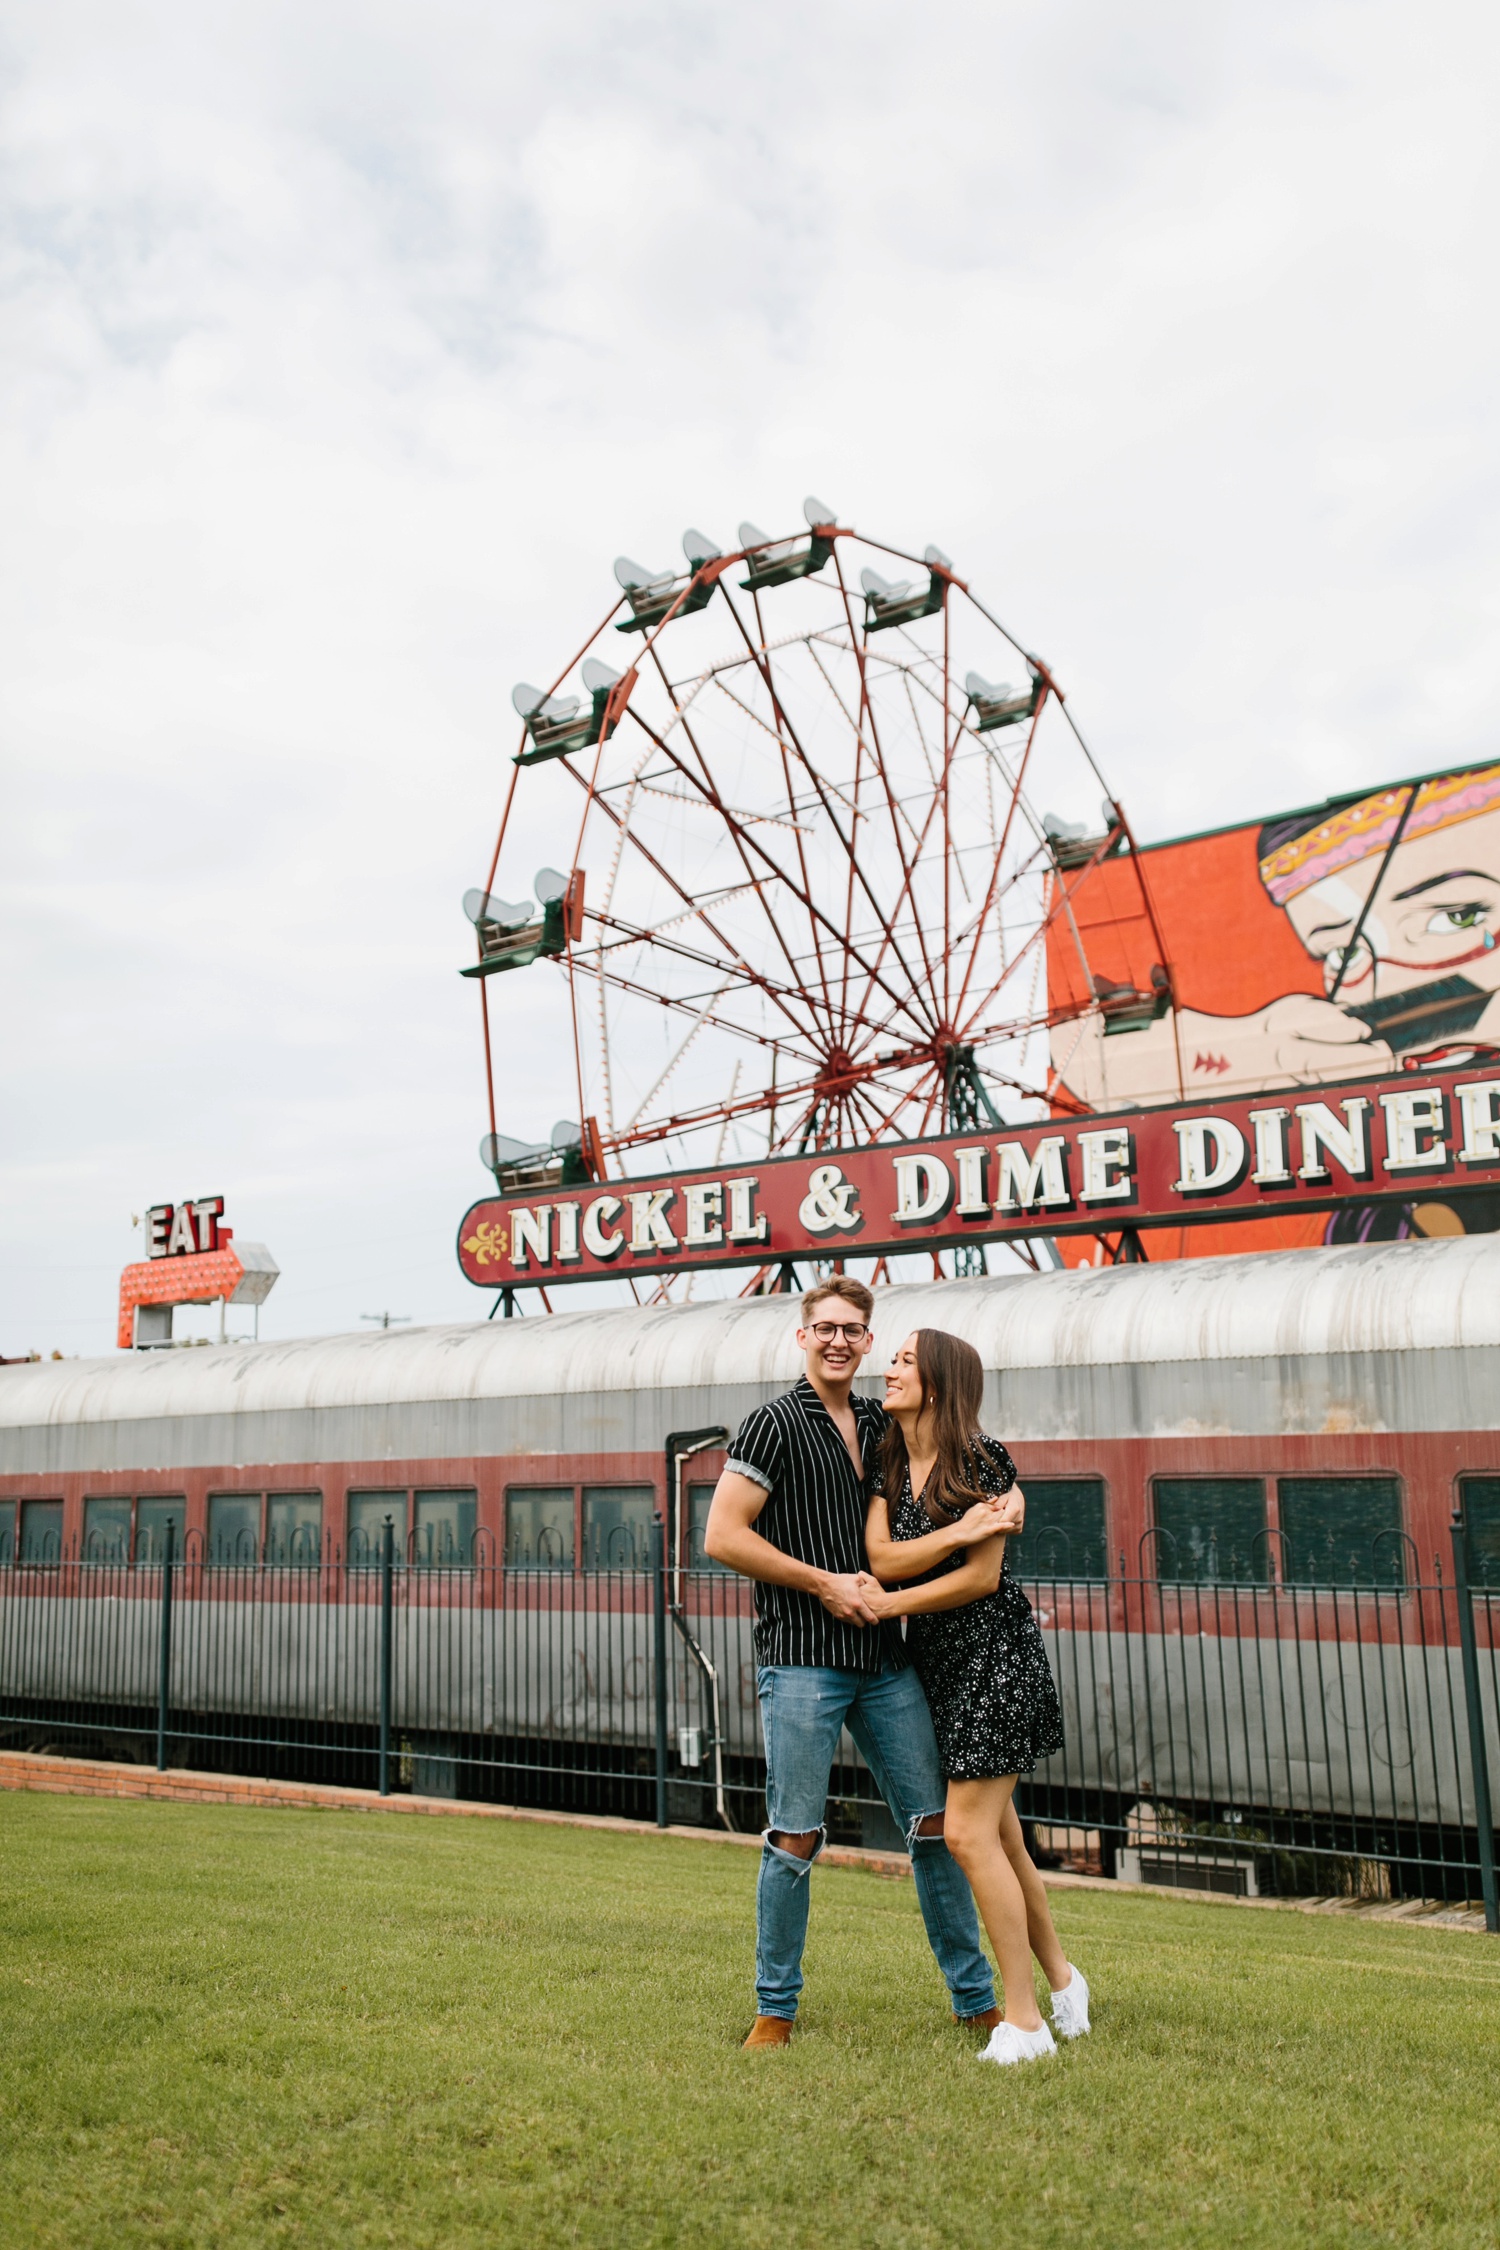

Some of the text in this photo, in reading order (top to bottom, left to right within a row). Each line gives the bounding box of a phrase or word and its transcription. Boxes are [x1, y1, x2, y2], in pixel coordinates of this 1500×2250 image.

[146, 1196, 223, 1259] EAT
[509, 1079, 1500, 1265] NICKEL & DIME DINER
